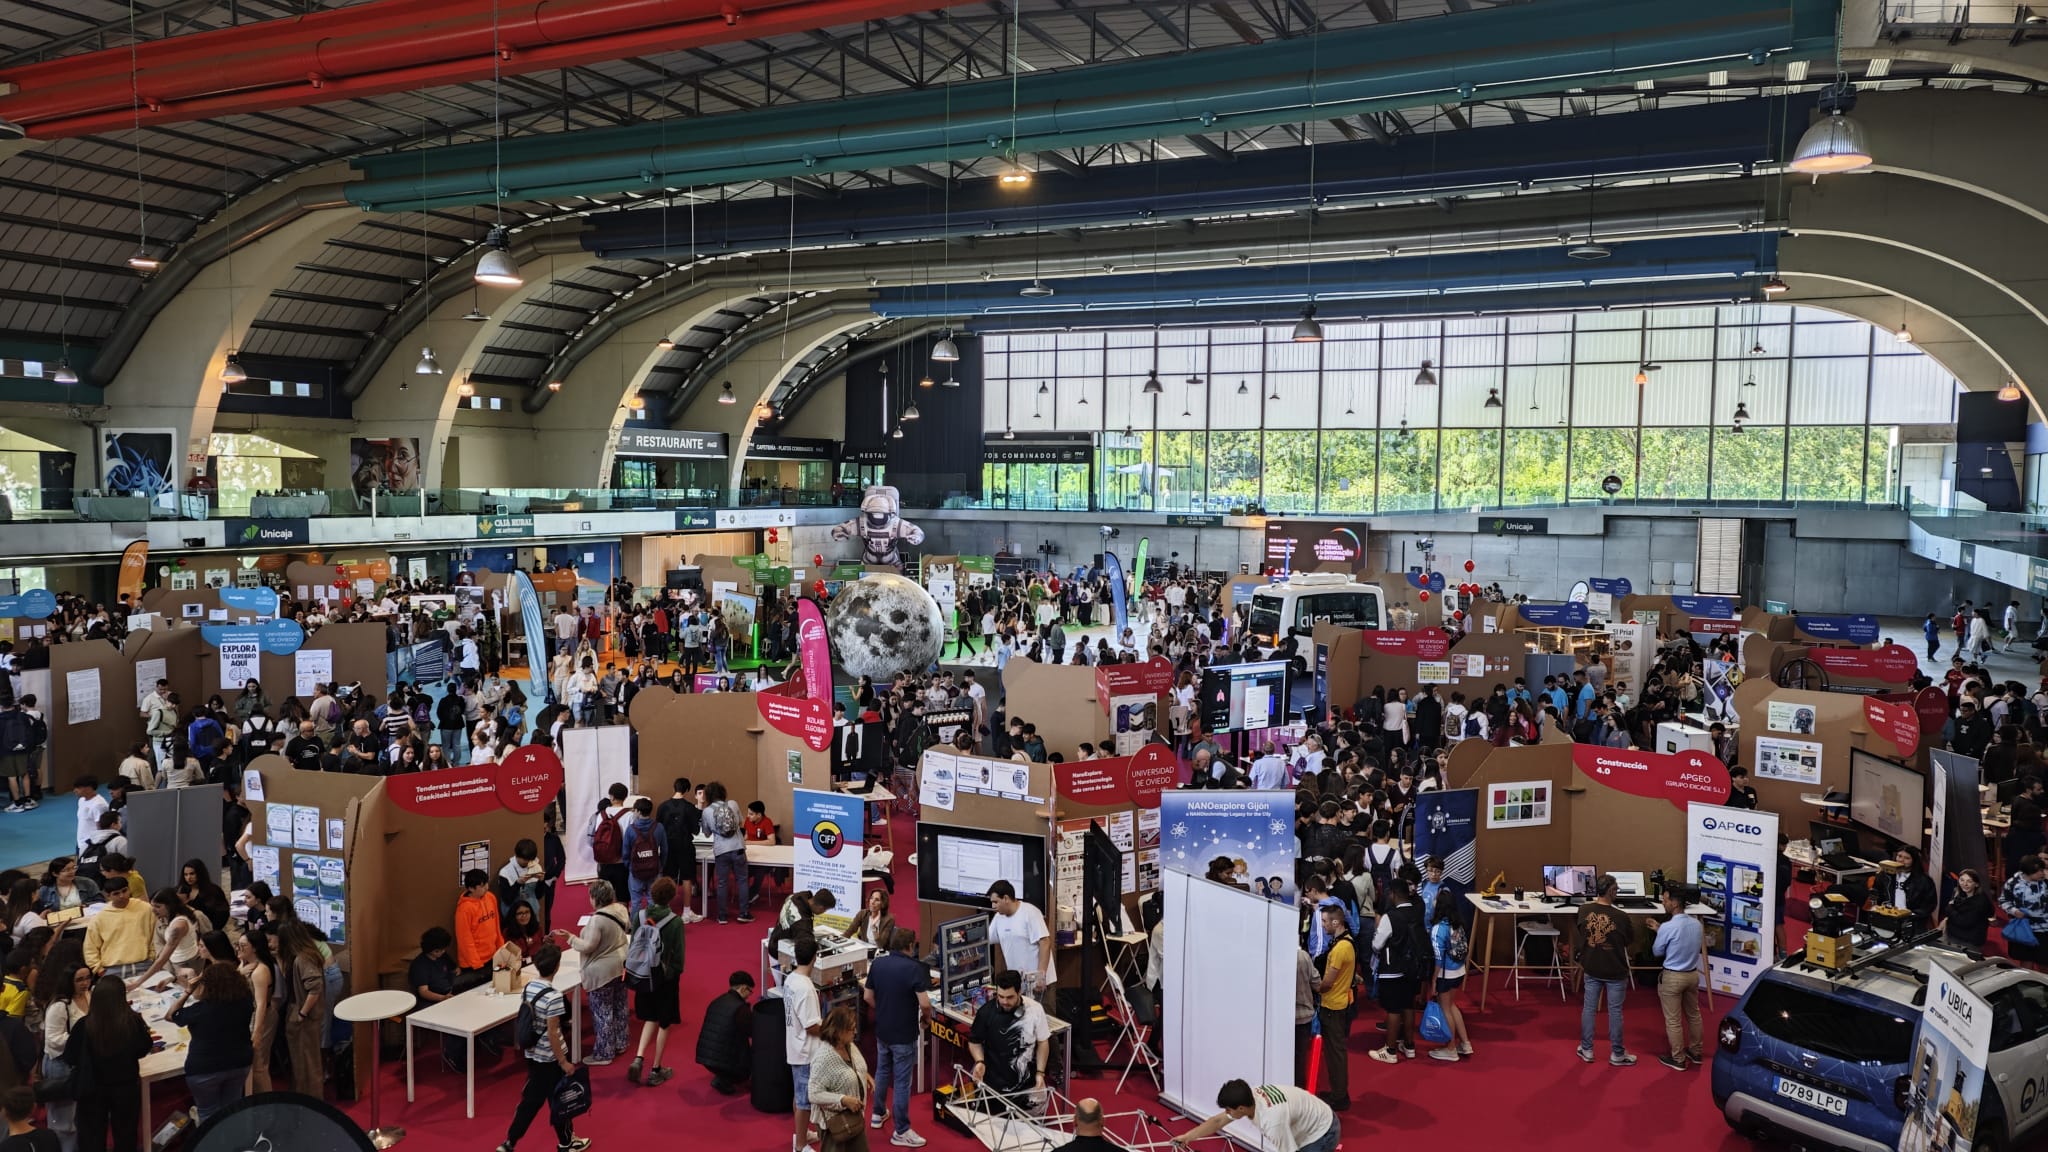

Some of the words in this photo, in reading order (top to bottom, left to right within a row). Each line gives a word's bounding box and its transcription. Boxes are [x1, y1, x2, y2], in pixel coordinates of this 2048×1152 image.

[636, 435, 704, 450] RESTAURANTE
[1506, 522, 1534, 532] Unicaja
[260, 528, 293, 540] Unicaja
[524, 754, 535, 763] 74
[1596, 757, 1648, 771] Construcción
[1690, 758, 1702, 767] 64
[1131, 766, 1175, 778] UNIVERSIDAD
[1596, 767, 1611, 775] 4.0
[511, 773, 549, 786] ELHUYAR
[1146, 776, 1171, 786] OVIEDO
[1680, 772, 1712, 784] APGEO
[1187, 801, 1246, 811] NANOexplore
[1247, 801, 1270, 811] Gijón
[1718, 818, 1762, 836] APGEO
[819, 833, 836, 845] CIFP
[1948, 988, 1972, 1024] UBICA
[1771, 1063, 1847, 1095] DUSTER
[2036, 1074, 2048, 1103] A
[1781, 1080, 1814, 1102] 0789
[1817, 1092, 1844, 1112] LPC
